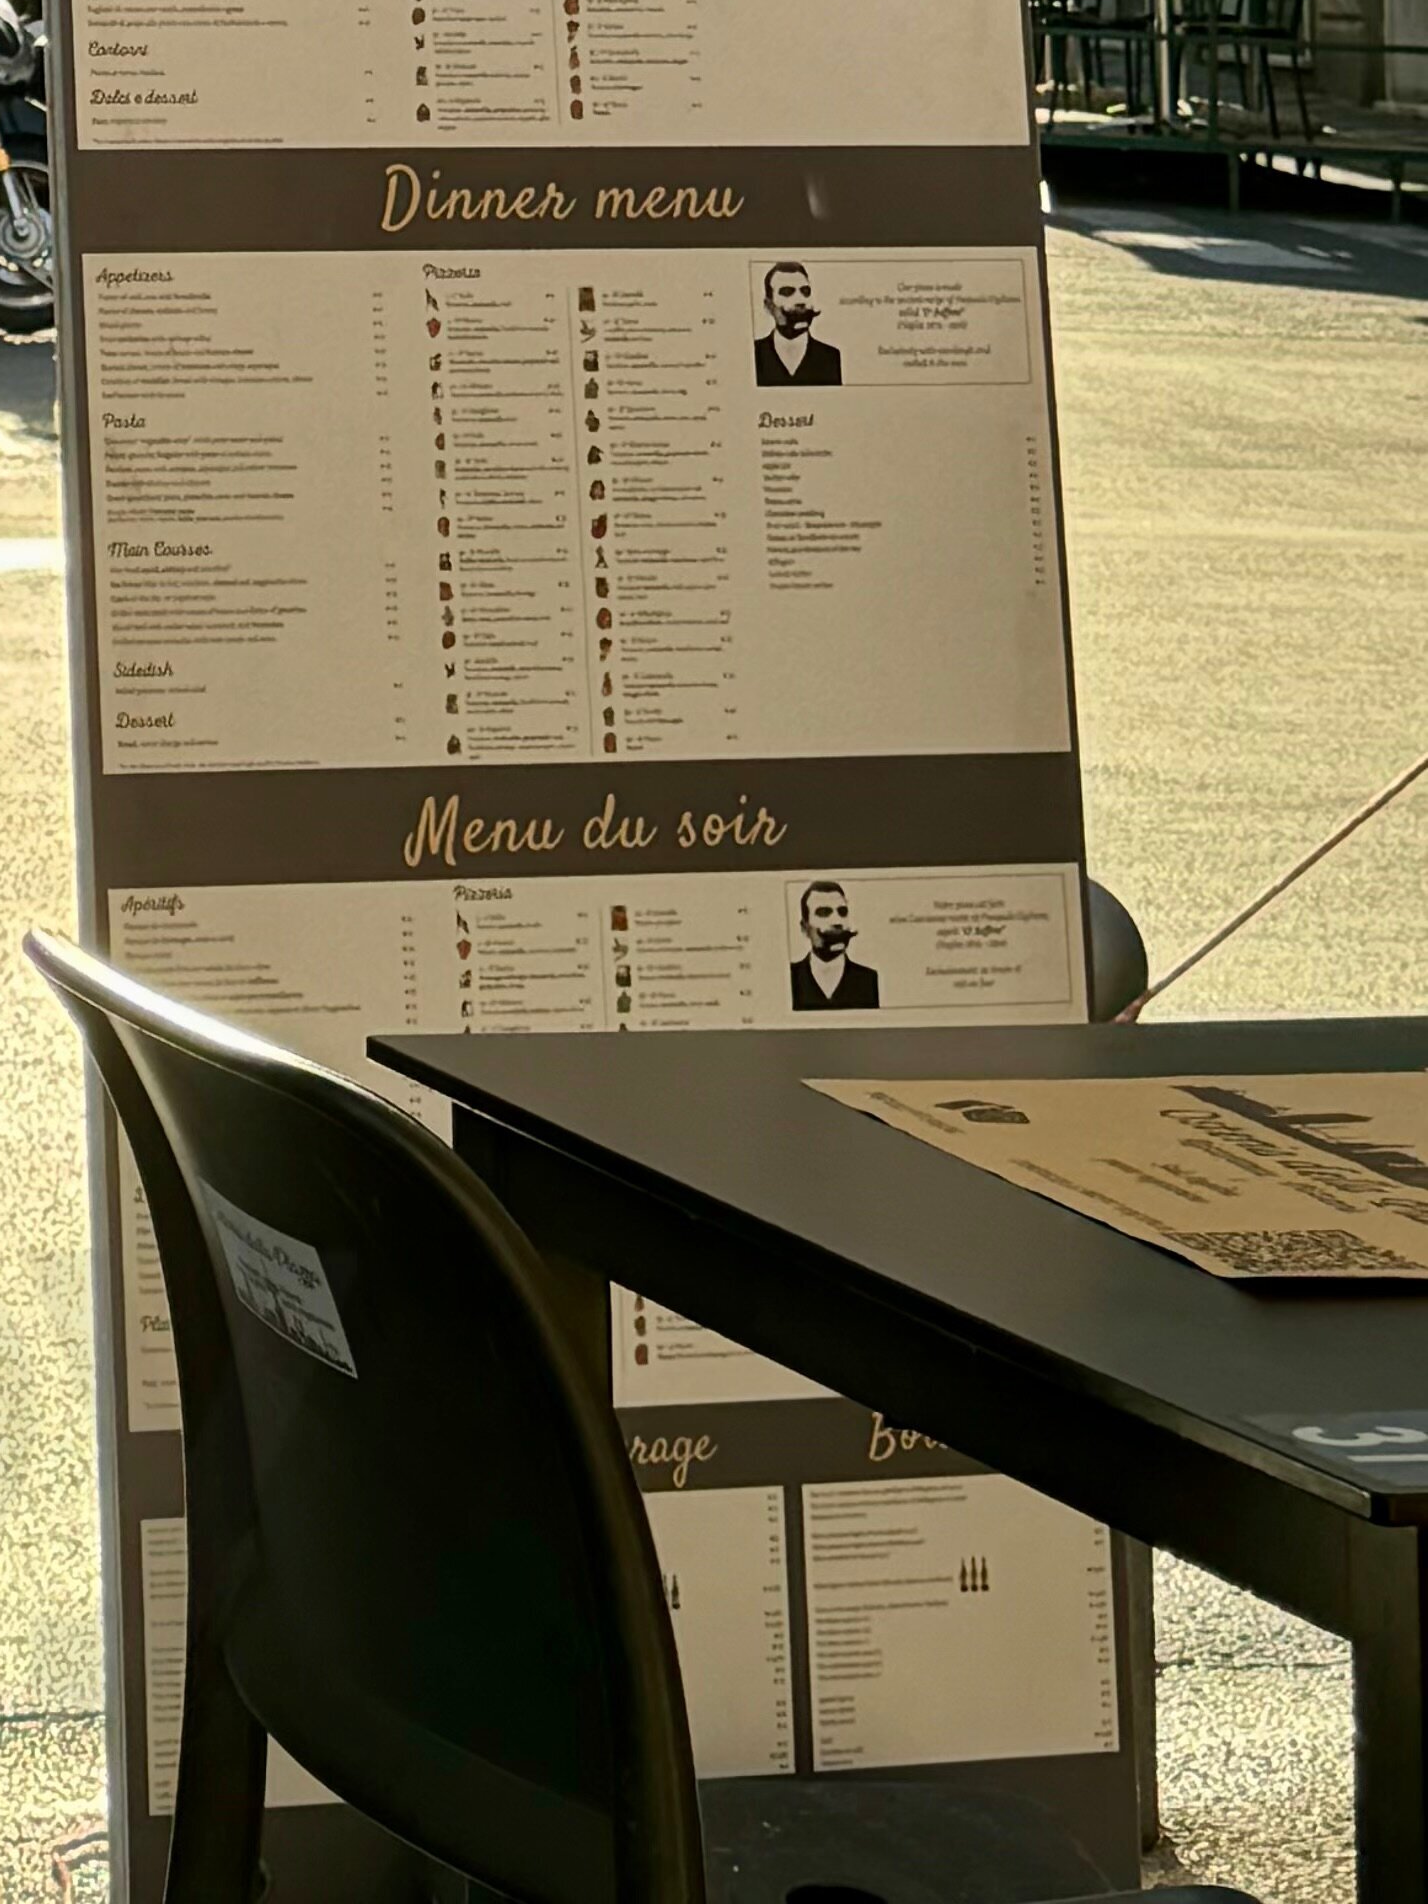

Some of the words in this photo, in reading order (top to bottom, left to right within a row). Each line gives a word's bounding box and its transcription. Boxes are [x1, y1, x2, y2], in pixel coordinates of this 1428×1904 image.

[380, 162, 575, 233] Dinner
[597, 185, 744, 222] menu
[102, 414, 146, 429] Pasta
[107, 542, 149, 558] Main
[154, 542, 213, 558] Courses
[404, 795, 564, 867] Menu
[582, 793, 658, 850] du
[678, 794, 788, 849] soir
[625, 1432, 717, 1489] rage
